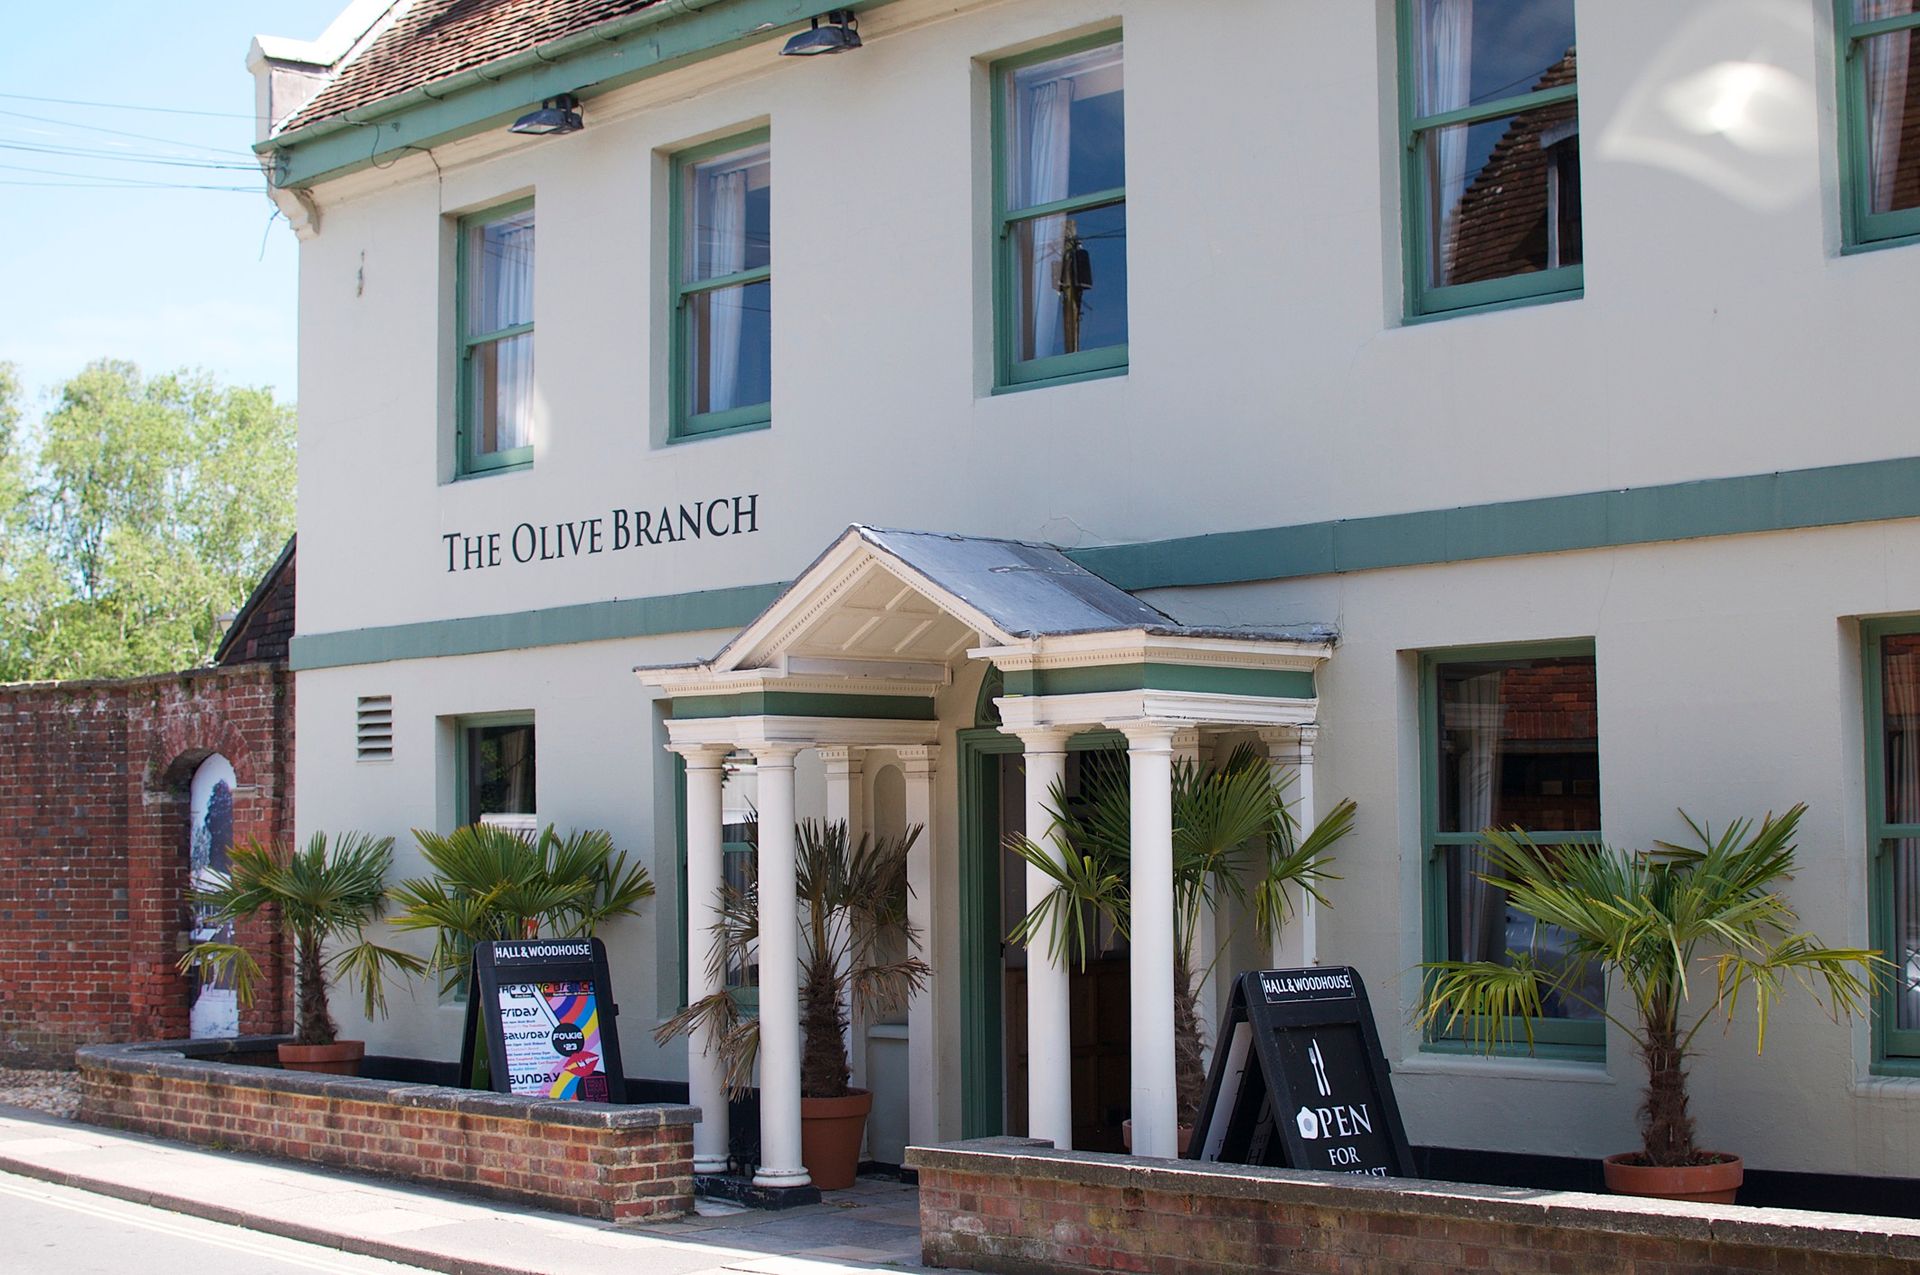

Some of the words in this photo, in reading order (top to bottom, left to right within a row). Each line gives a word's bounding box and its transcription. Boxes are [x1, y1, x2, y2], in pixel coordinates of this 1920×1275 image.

[443, 532, 501, 572] THE
[512, 518, 603, 563] OLIVE
[612, 494, 759, 551] BRANCH
[1328, 1147, 1361, 1166] FOR
